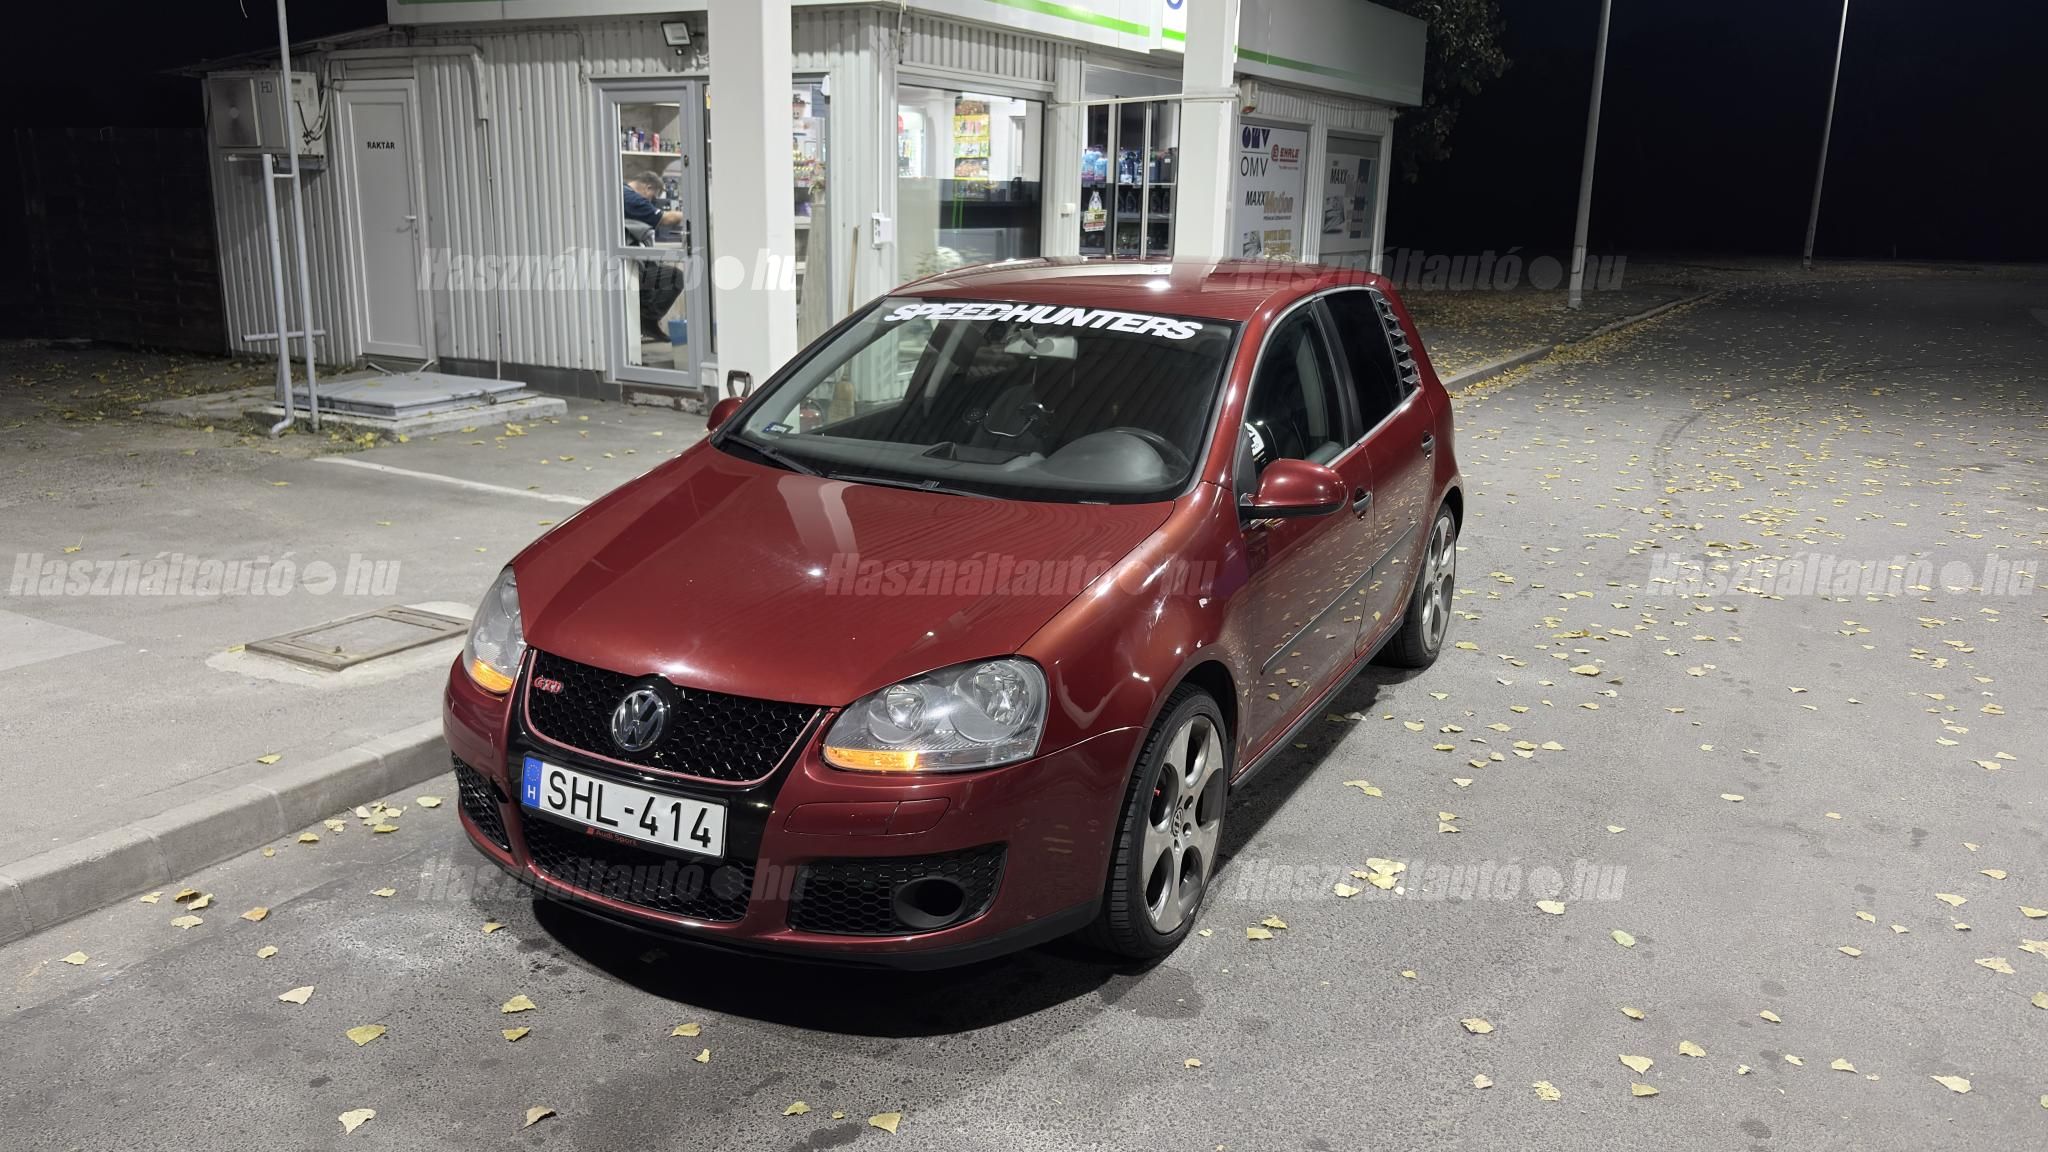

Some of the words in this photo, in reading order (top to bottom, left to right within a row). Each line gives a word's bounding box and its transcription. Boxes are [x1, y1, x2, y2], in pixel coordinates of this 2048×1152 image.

[1240, 156, 1269, 177] OMV
[884, 302, 1203, 341] SPEEDHUNTERS
[527, 784, 537, 801] H
[547, 770, 712, 849] SHL-414
